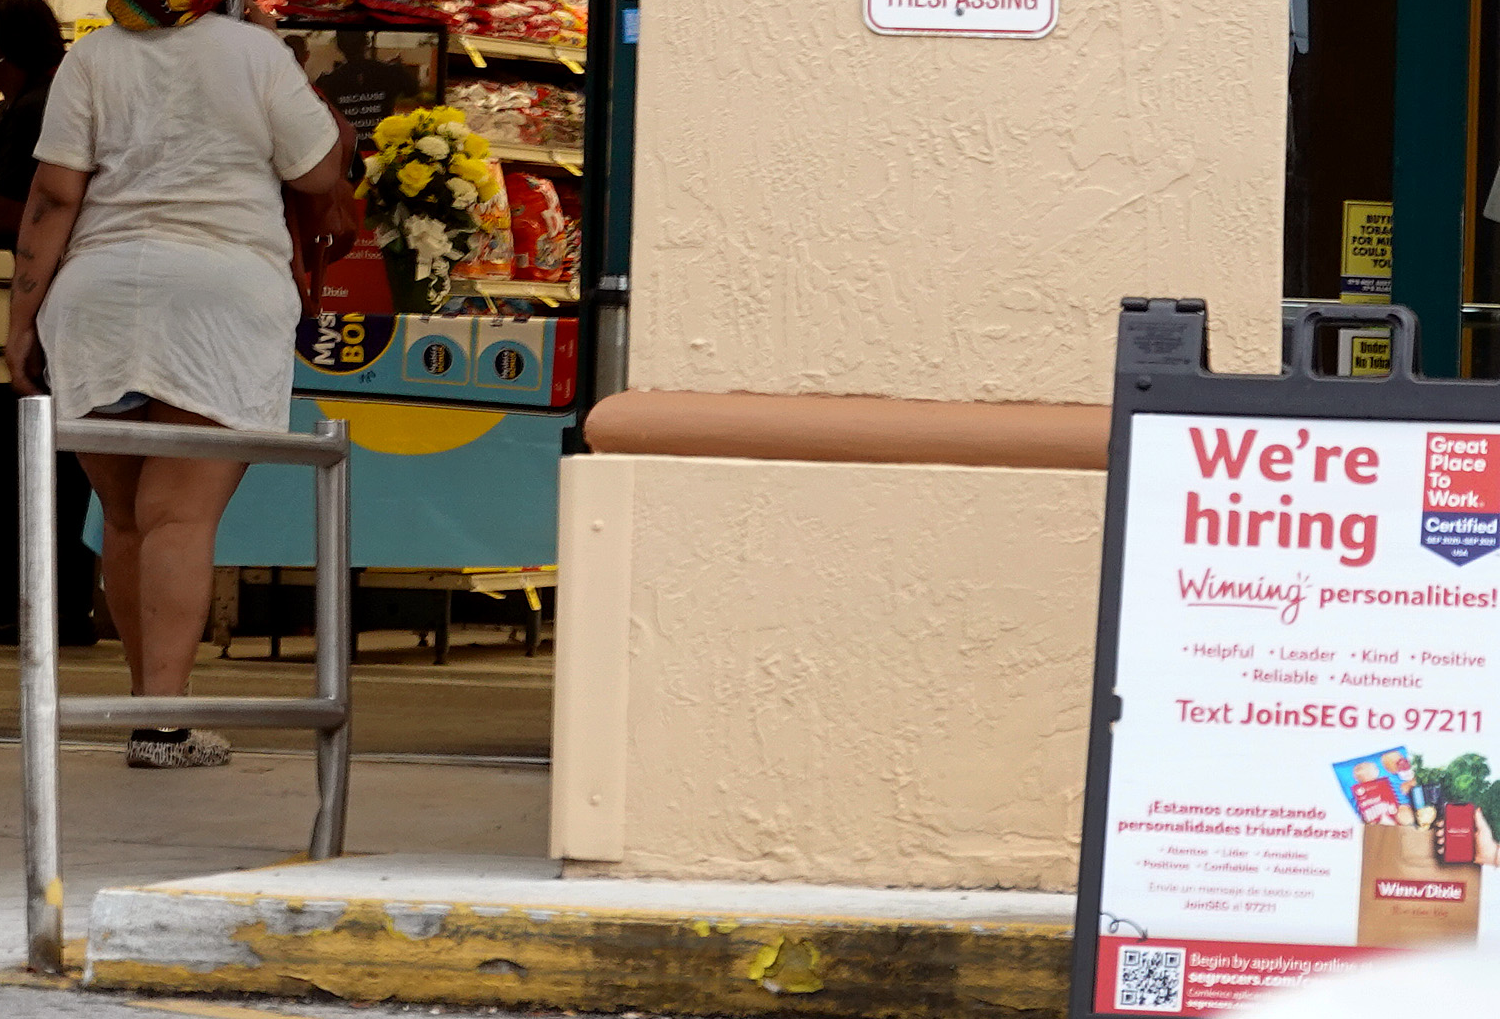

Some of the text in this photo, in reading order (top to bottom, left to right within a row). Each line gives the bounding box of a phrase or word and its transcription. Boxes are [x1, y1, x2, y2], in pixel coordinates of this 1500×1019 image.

[1360, 341, 1389, 354] Under
[1430, 436, 1488, 455] Great
[1188, 427, 1380, 484] We're
[1430, 454, 1486, 472] Place
[1428, 472, 1451, 488] To
[1184, 491, 1379, 568] hiring
[1425, 517, 1498, 534] Certified
[1178, 568, 1498, 626] Winning personalities!
[1193, 643, 1486, 668] Helpful Leader Kind Positive
[1252, 669, 1423, 688] Reliable Authentic
[1176, 699, 1483, 733] Text JoinSEG to 97211
[1226, 805, 1327, 820] contratando
[1118, 819, 1241, 837] personalidades
[1189, 952, 1230, 971] Begin
[1232, 954, 1250, 971] by
[1250, 954, 1312, 975] applying
